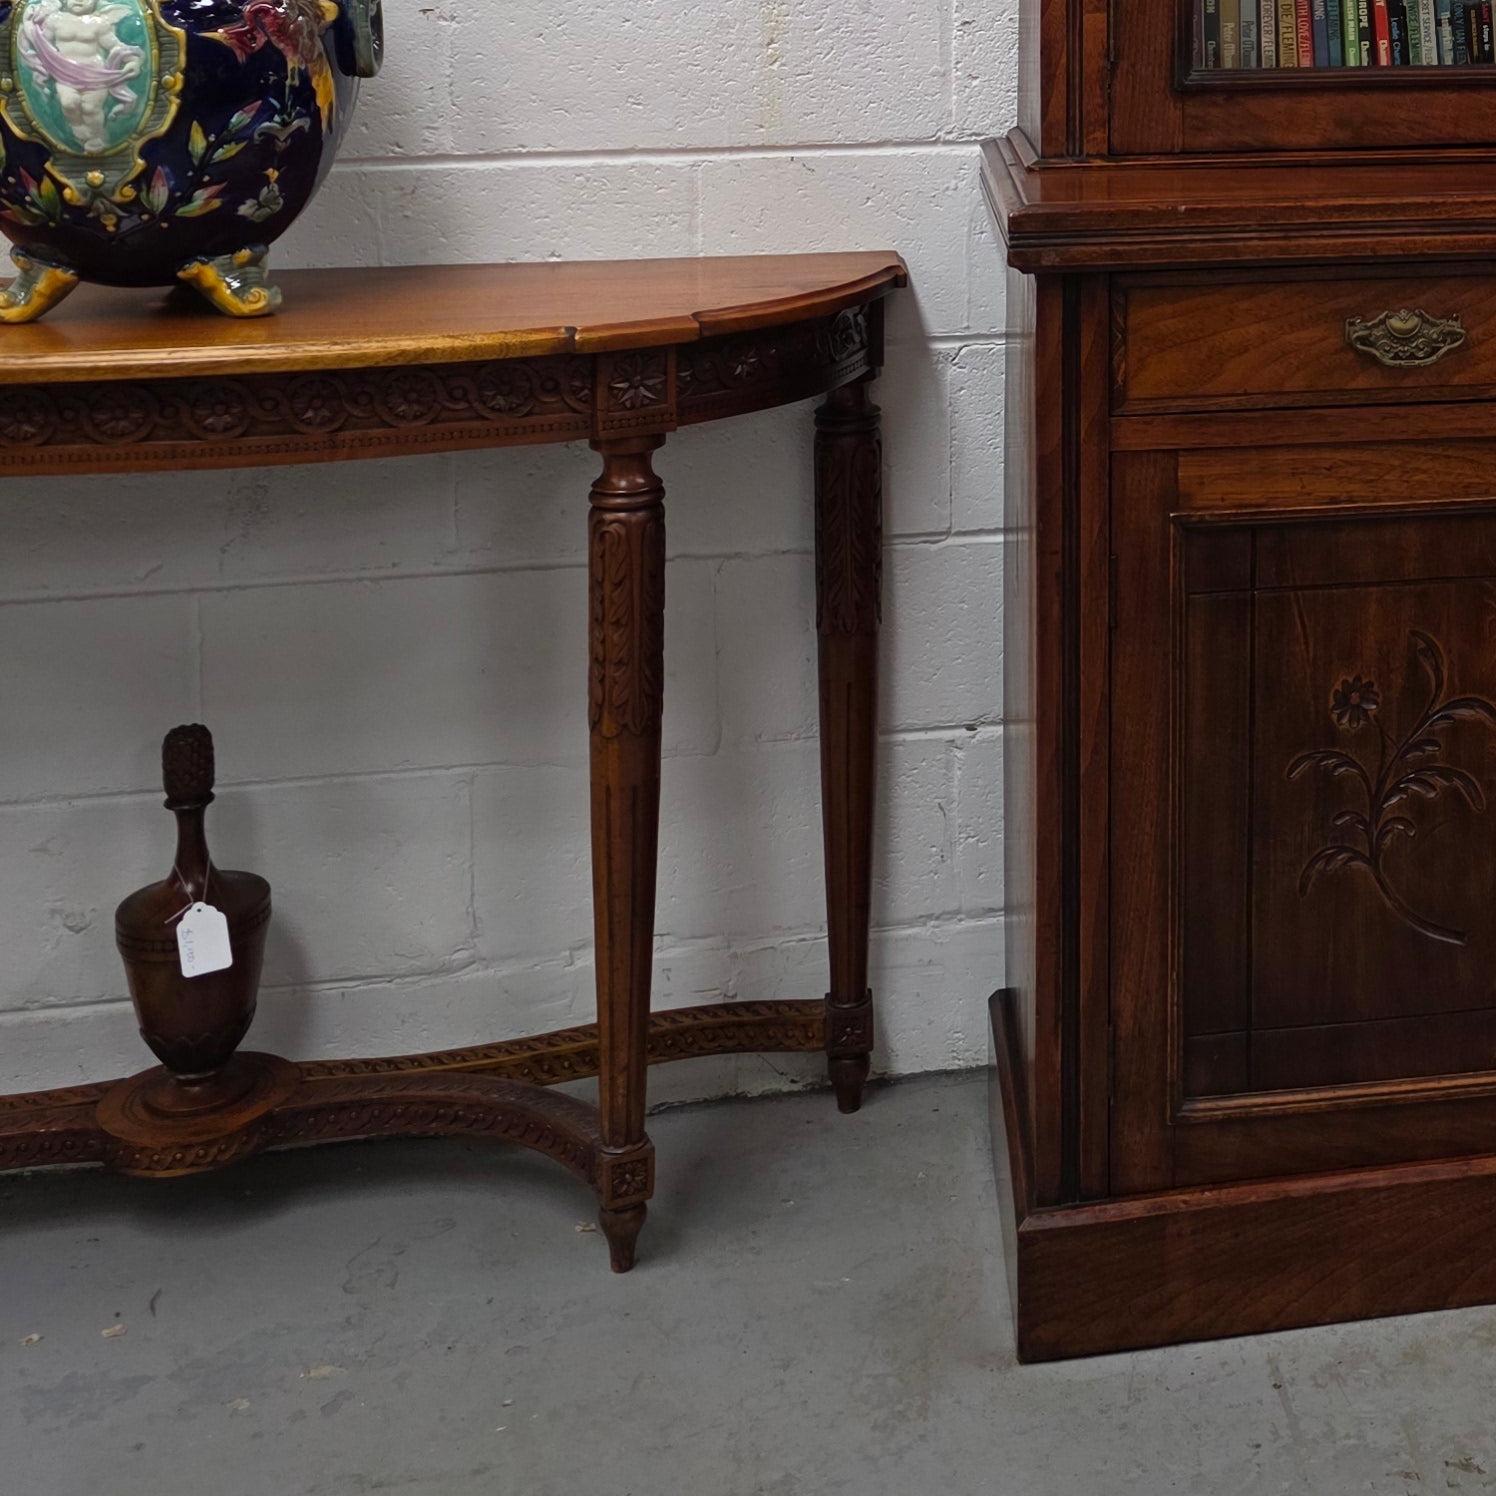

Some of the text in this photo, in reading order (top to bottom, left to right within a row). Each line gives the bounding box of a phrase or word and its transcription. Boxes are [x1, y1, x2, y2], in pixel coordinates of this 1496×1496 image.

[1206, 0, 1215, 13] ON
[1222, 22, 1236, 42] Peter
[1328, 5, 1339, 41] FLEMING
[1391, 17, 1399, 39] Leslie
